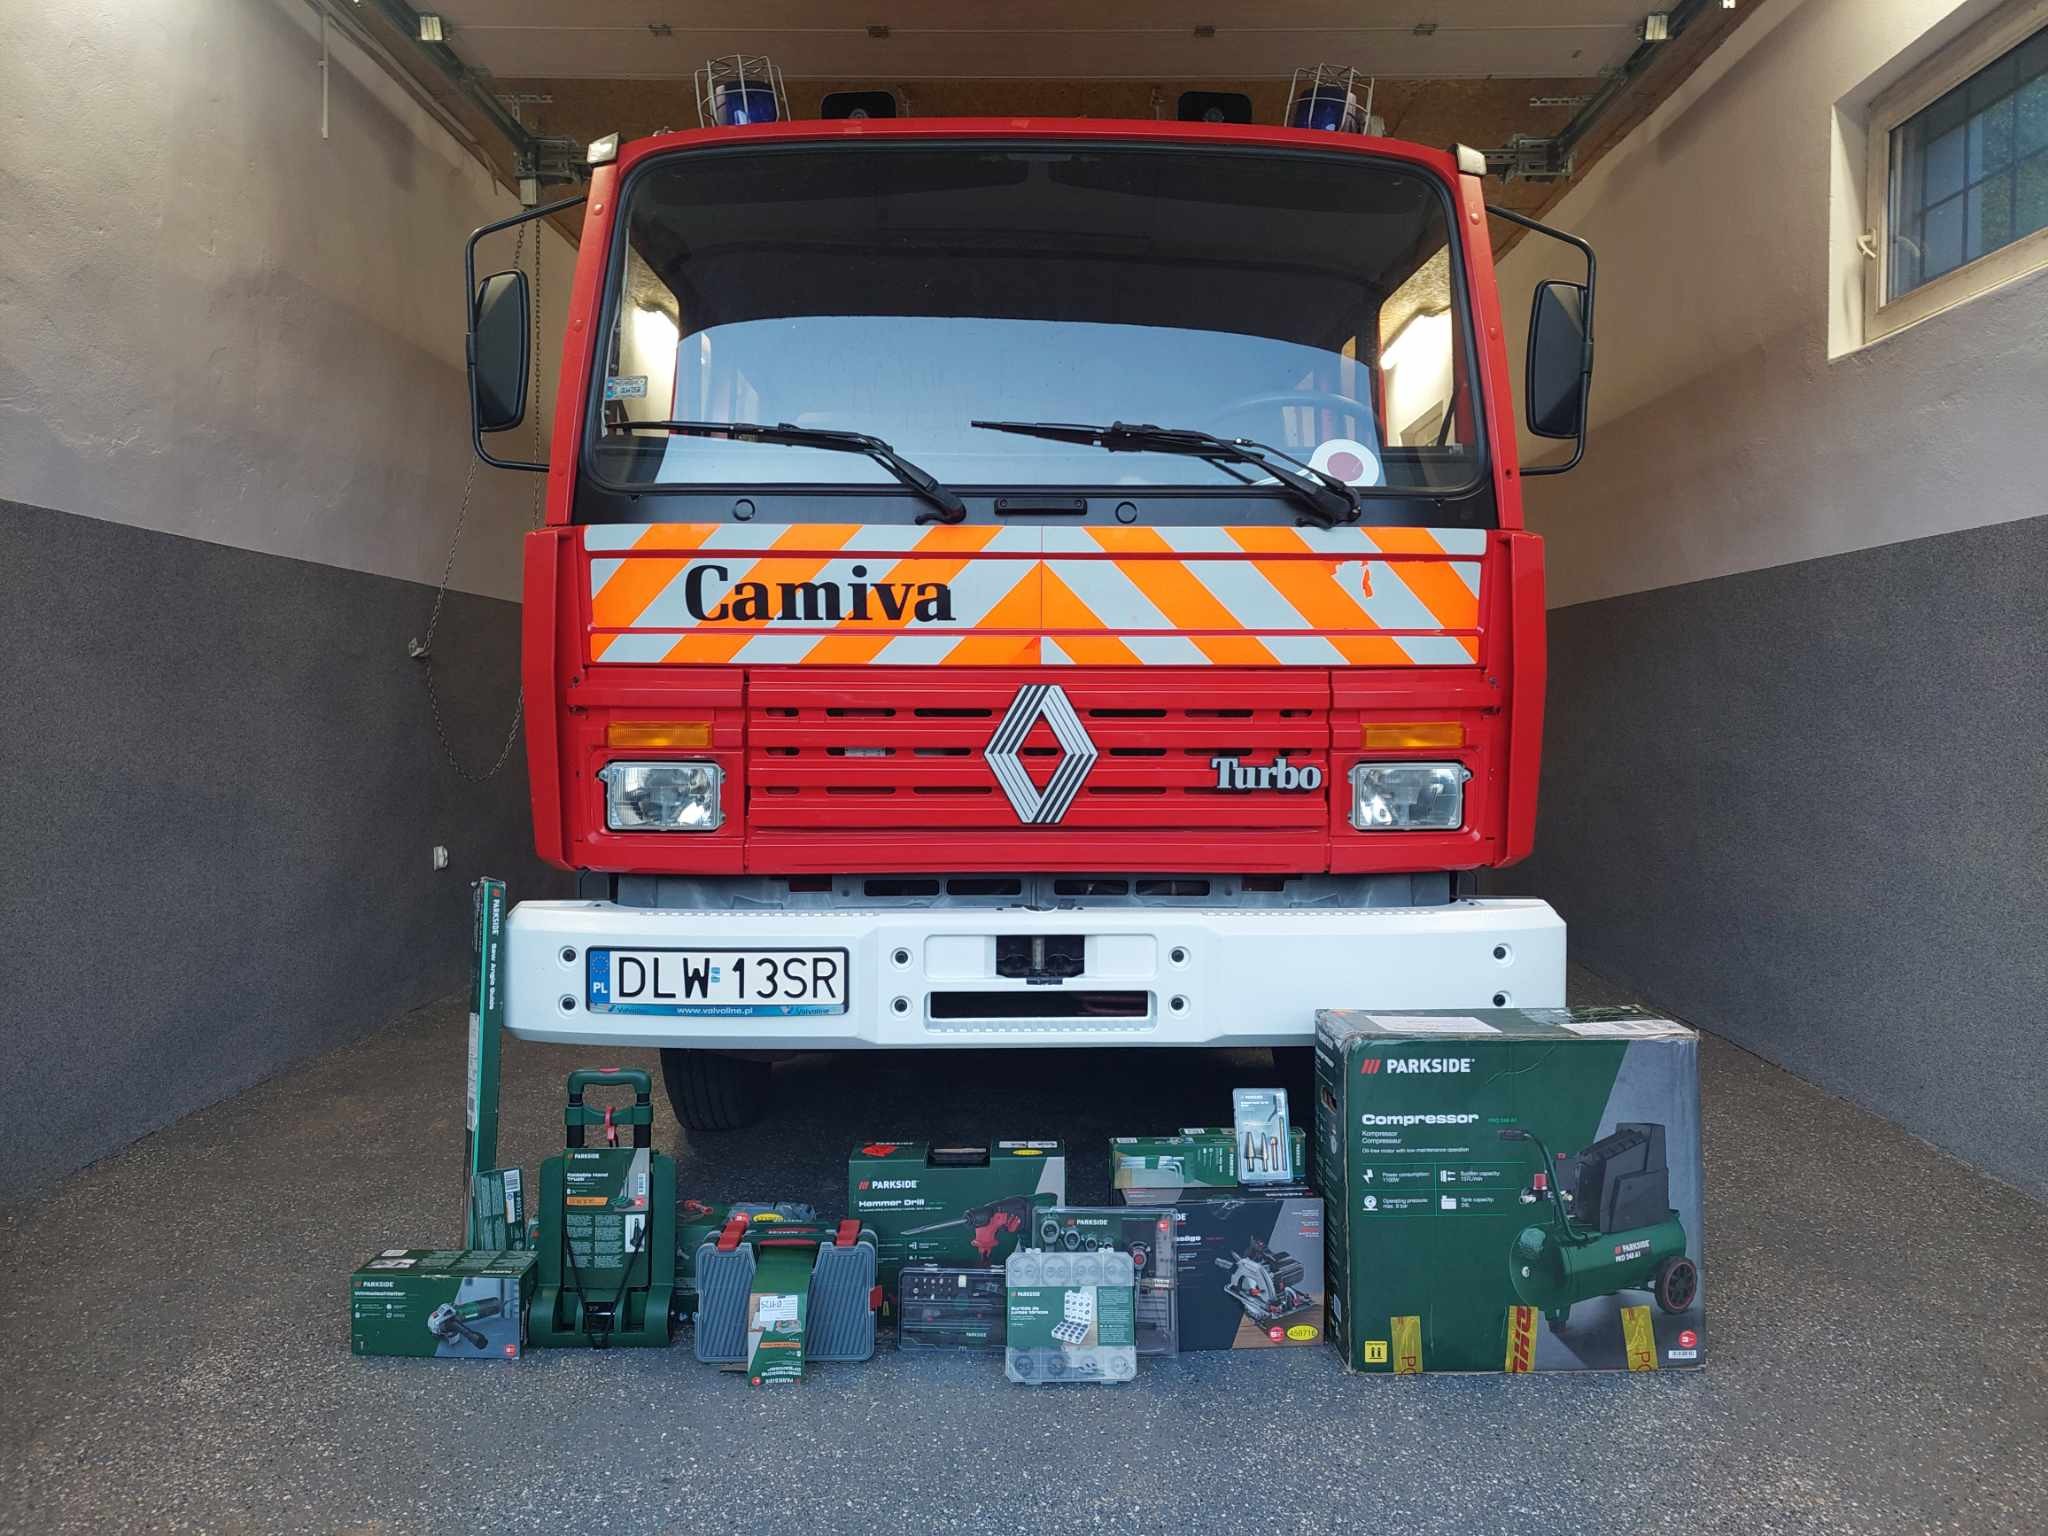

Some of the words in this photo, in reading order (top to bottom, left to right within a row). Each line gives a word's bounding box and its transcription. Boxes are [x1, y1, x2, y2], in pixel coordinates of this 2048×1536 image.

[685, 564, 956, 622] Camiva
[1212, 757, 1321, 789] Turbo
[492, 899, 501, 936] PARKSIDE
[618, 957, 711, 999] DLW
[732, 957, 837, 999] 13SR
[593, 982, 608, 994] PL
[676, 1007, 753, 1017] www.valvoline.pl
[1387, 1058, 1472, 1074] PARKSIDE
[1361, 1114, 1479, 1127] Compressor
[1361, 1130, 1398, 1138] Kompressor
[872, 1180, 918, 1189] PARKSIDE
[859, 1199, 902, 1208] Hammer
[904, 1198, 925, 1207] Drill
[1622, 1239, 1649, 1252] PARKSIDE
